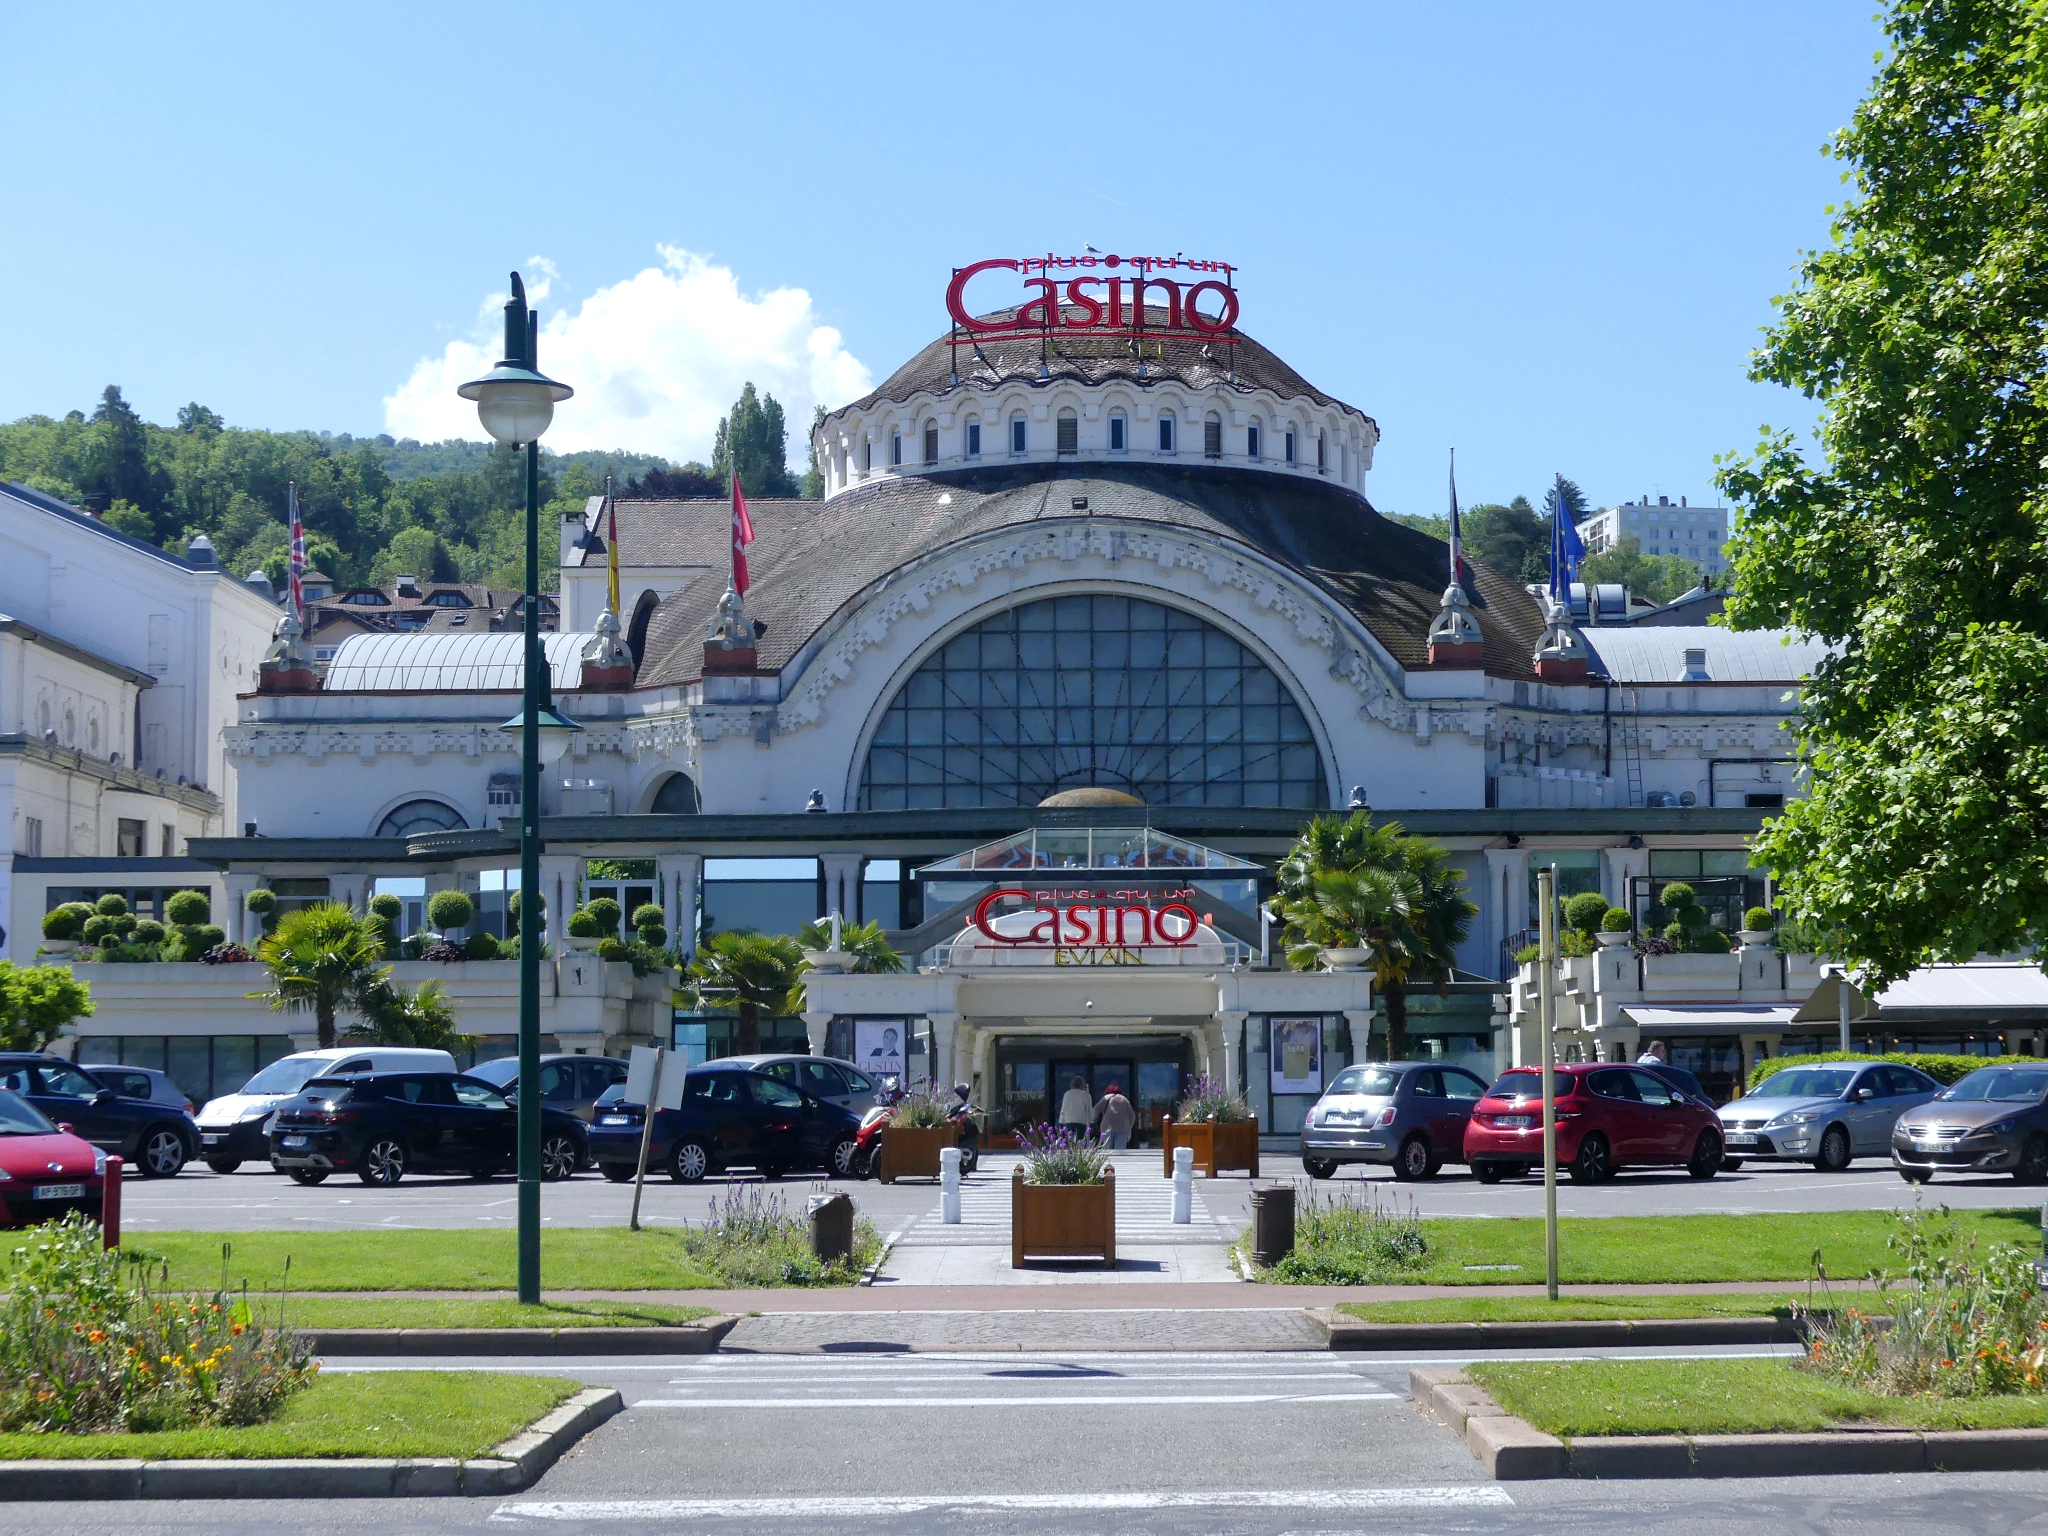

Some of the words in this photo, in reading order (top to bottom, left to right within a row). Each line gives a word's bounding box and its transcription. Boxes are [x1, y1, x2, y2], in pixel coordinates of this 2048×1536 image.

[1022, 253, 1097, 274] plus
[946, 258, 1239, 333] Casino
[1047, 340, 1164, 359] EVIAN
[1035, 889, 1091, 901] plus
[975, 889, 1199, 944] Casino
[1055, 949, 1143, 965] EVIAN
